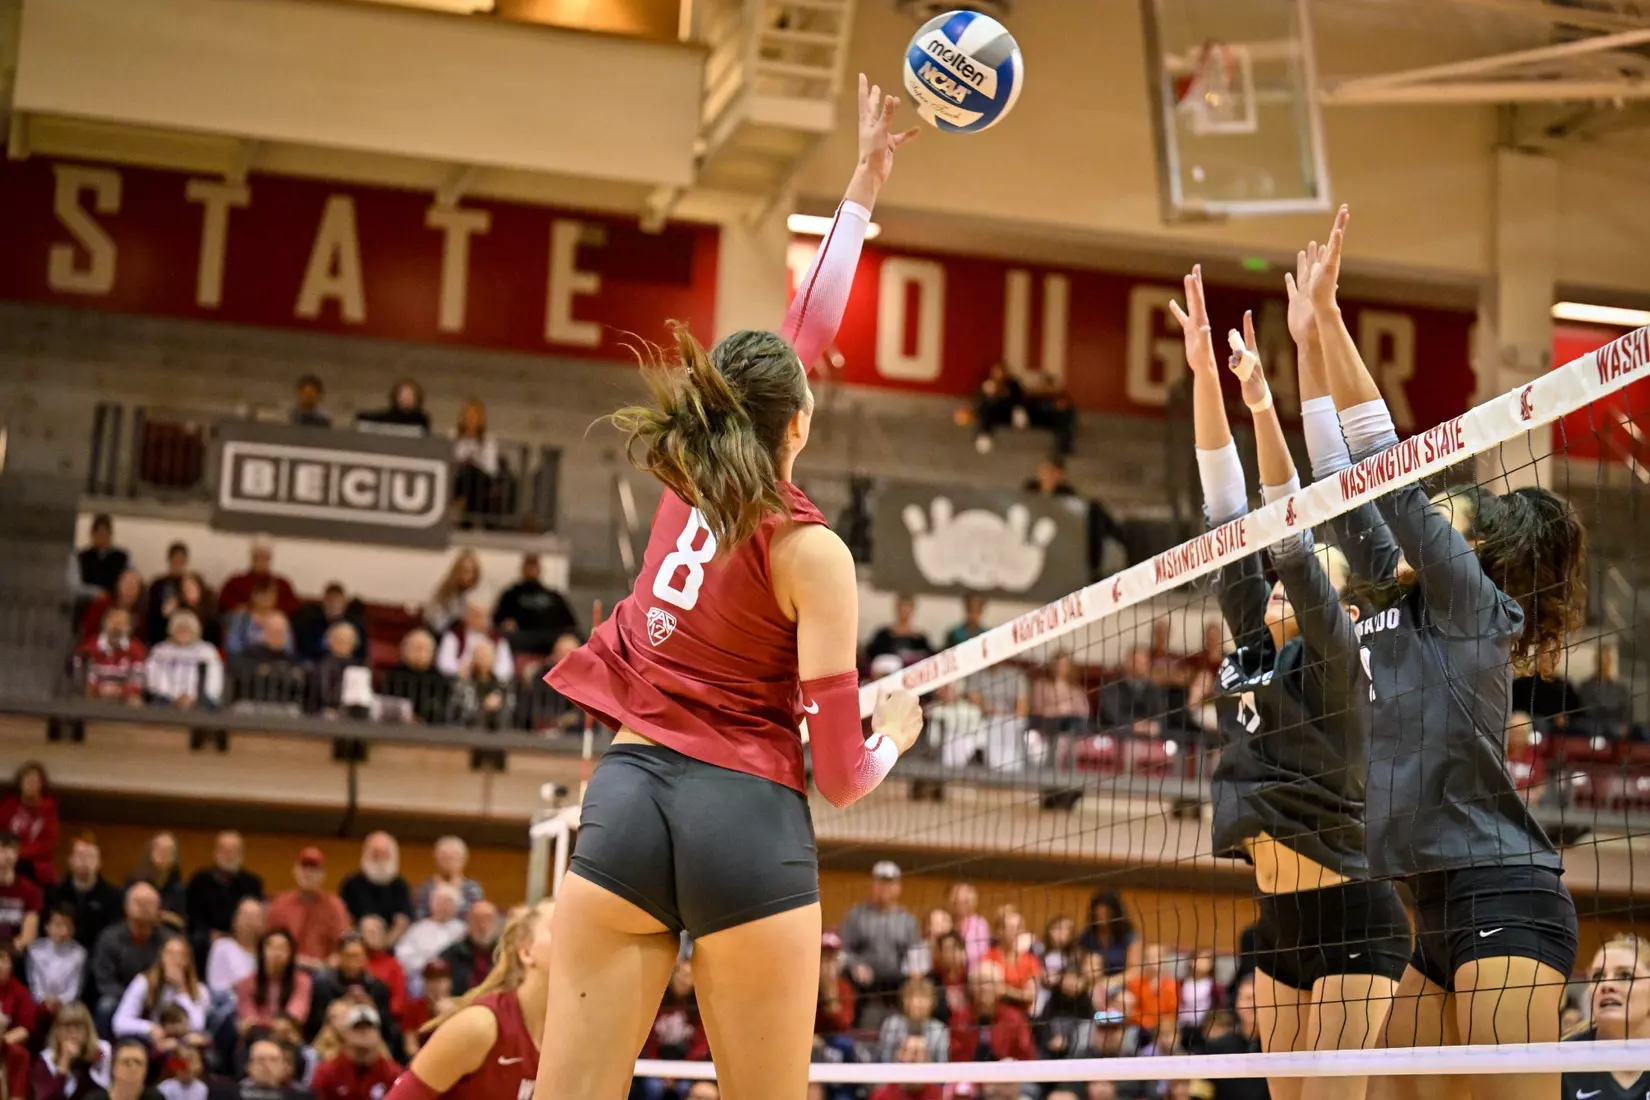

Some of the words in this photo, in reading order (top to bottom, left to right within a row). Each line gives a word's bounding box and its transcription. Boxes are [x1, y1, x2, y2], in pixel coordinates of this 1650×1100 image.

[918, 61, 970, 104] NCAA
[927, 39, 985, 87] molten
[46, 164, 606, 348] STATE
[240, 457, 430, 512] BECU
[1339, 434, 1421, 501] WASHINGTON
[1423, 415, 1465, 463] STATE
[652, 507, 717, 611] 8
[1153, 532, 1215, 584] WASHINGTON
[1215, 518, 1247, 557] STATE
[647, 607, 676, 632] PAC
[650, 625, 666, 640] 12
